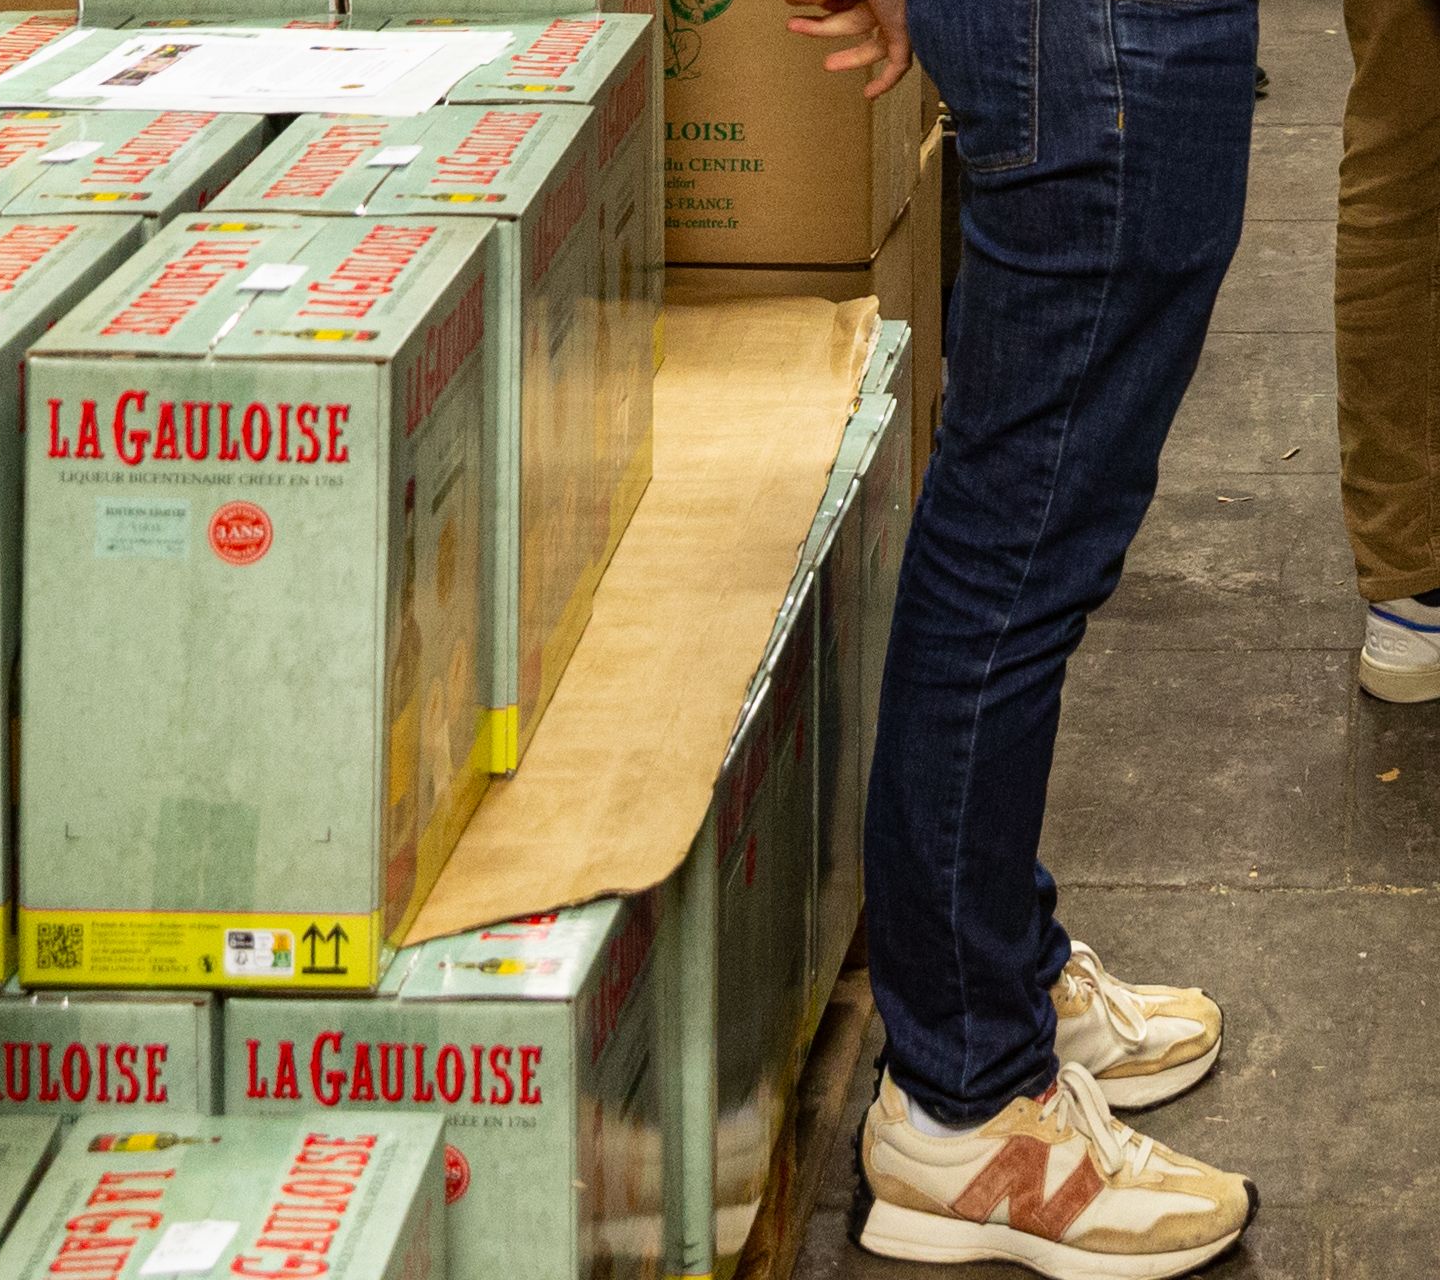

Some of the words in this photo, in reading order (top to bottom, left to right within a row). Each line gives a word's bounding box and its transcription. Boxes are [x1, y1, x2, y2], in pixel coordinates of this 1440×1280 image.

[665, 122, 747, 142] LOISE
[688, 157, 765, 173] CENTRE
[47, 398, 103, 460] LA
[111, 389, 349, 467] GAULOISE
[289, 472, 310, 487] EN
[231, 524, 265, 539] ANS
[245, 1039, 300, 1100] LA
[308, 1030, 542, 1107] GAULOISE
[446, 1114, 481, 1128] RÉÉE
[484, 1116, 506, 1128] EN
[507, 1117, 537, 1130] 1783
